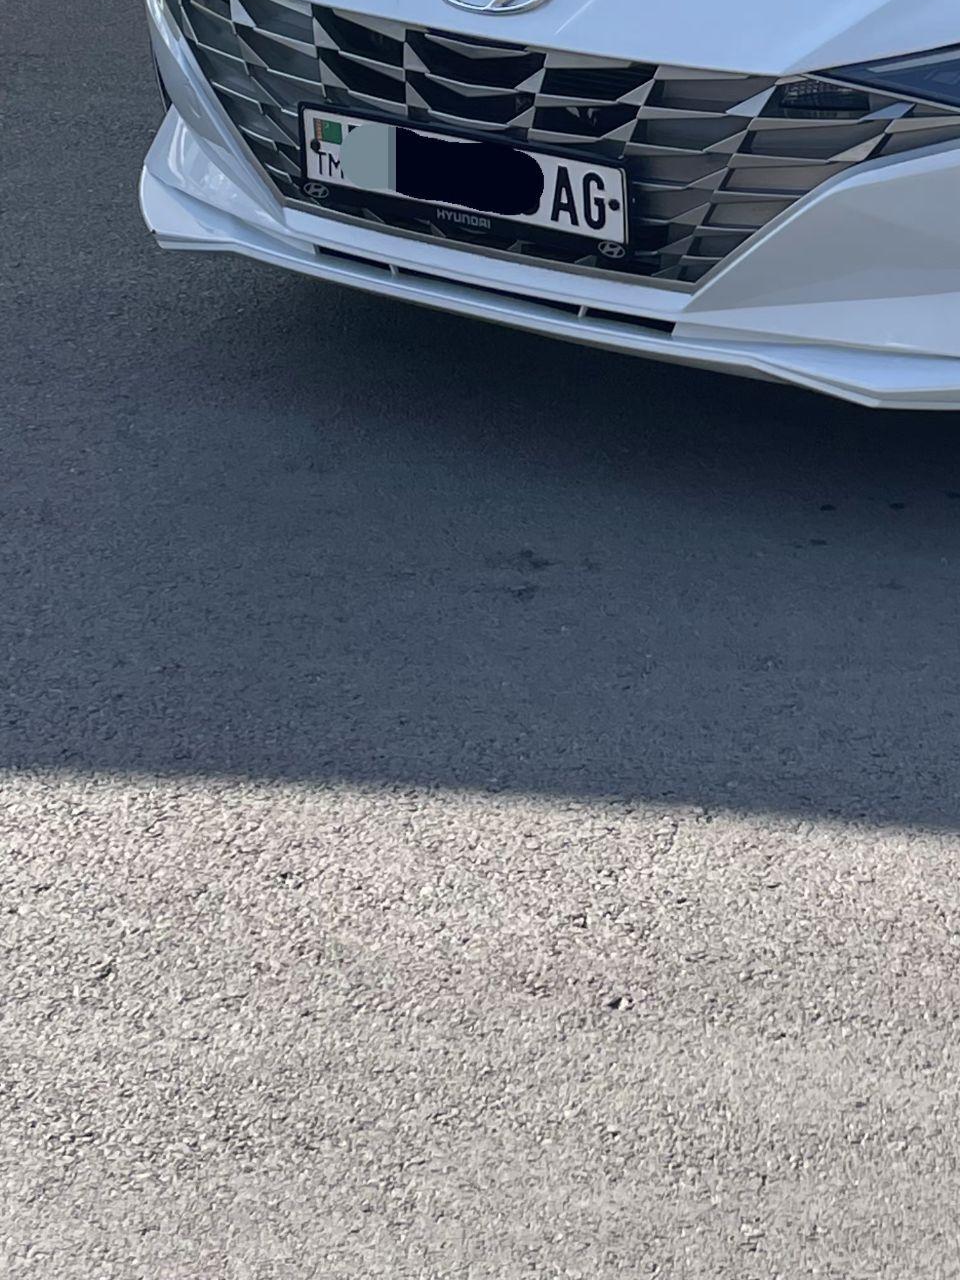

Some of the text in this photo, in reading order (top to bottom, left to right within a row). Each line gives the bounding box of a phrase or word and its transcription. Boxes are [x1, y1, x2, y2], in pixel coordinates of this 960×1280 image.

[317, 150, 344, 179] TM
[551, 165, 606, 230] AG
[436, 208, 491, 229] HYUNDAI
